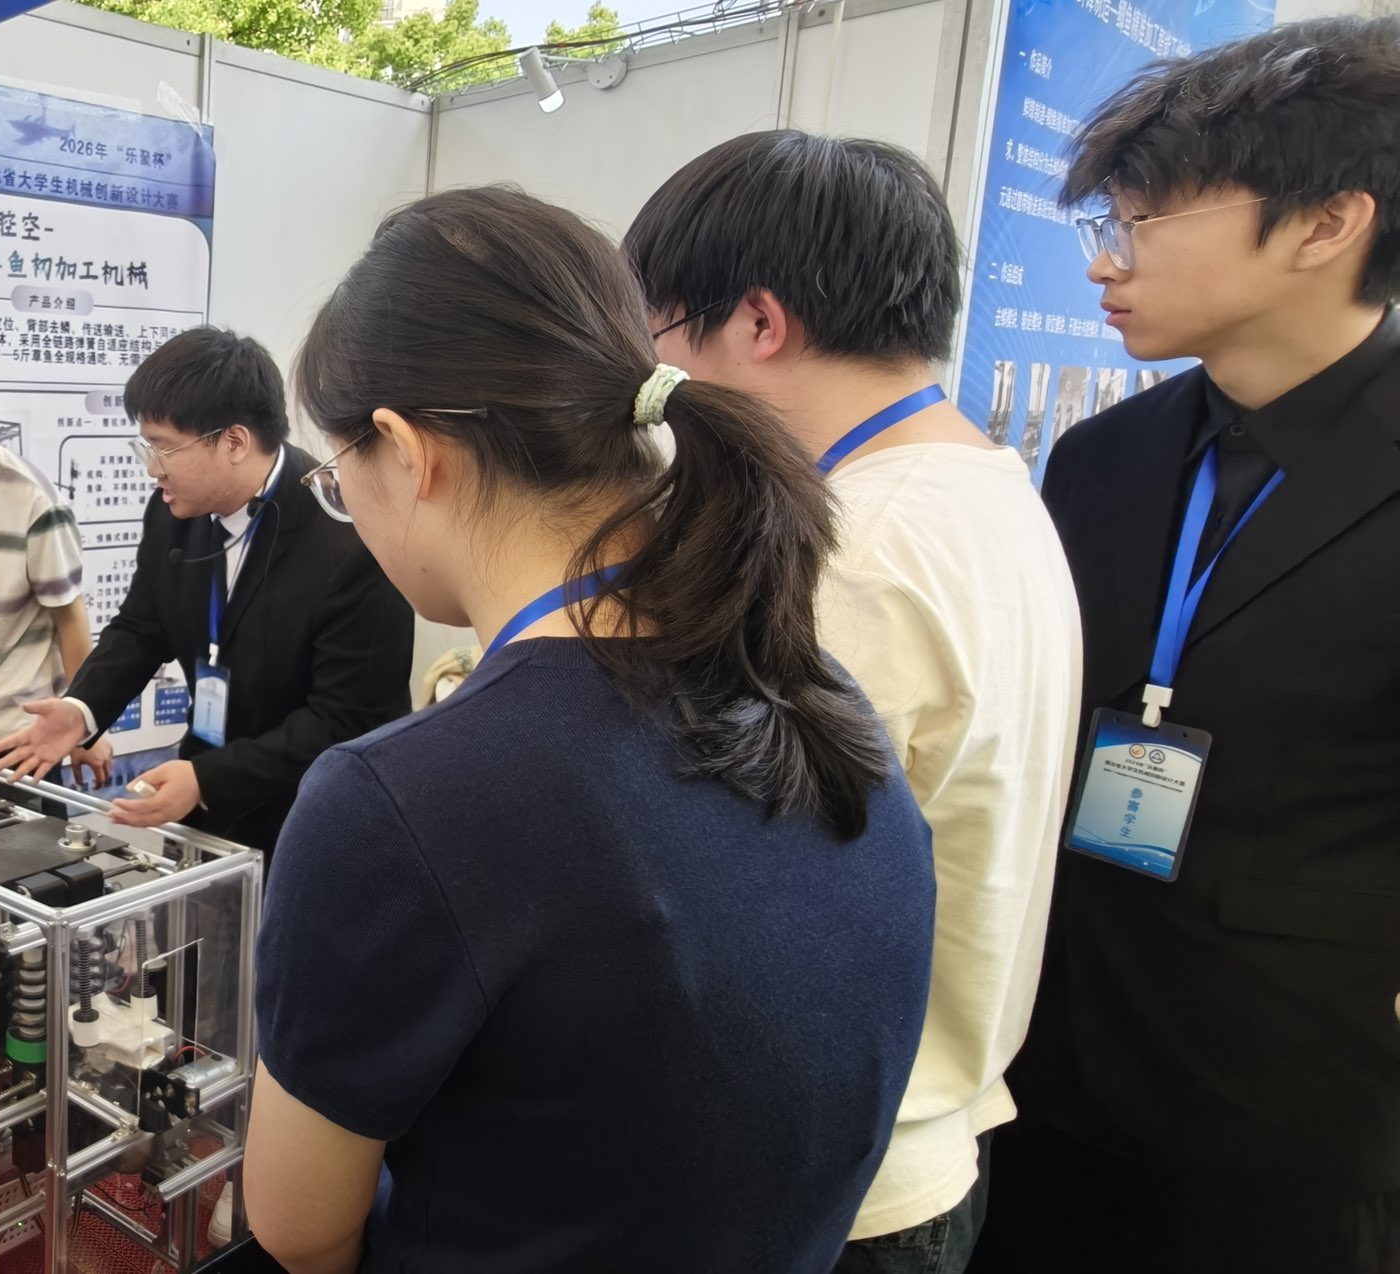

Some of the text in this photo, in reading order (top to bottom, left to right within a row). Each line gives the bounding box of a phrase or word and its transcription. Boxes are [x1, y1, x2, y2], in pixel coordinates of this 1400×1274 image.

[59, 136, 108, 160] 2026年
[29, 294, 76, 310] 产品介绍
[1120, 787, 1143, 839] 参赛学生
